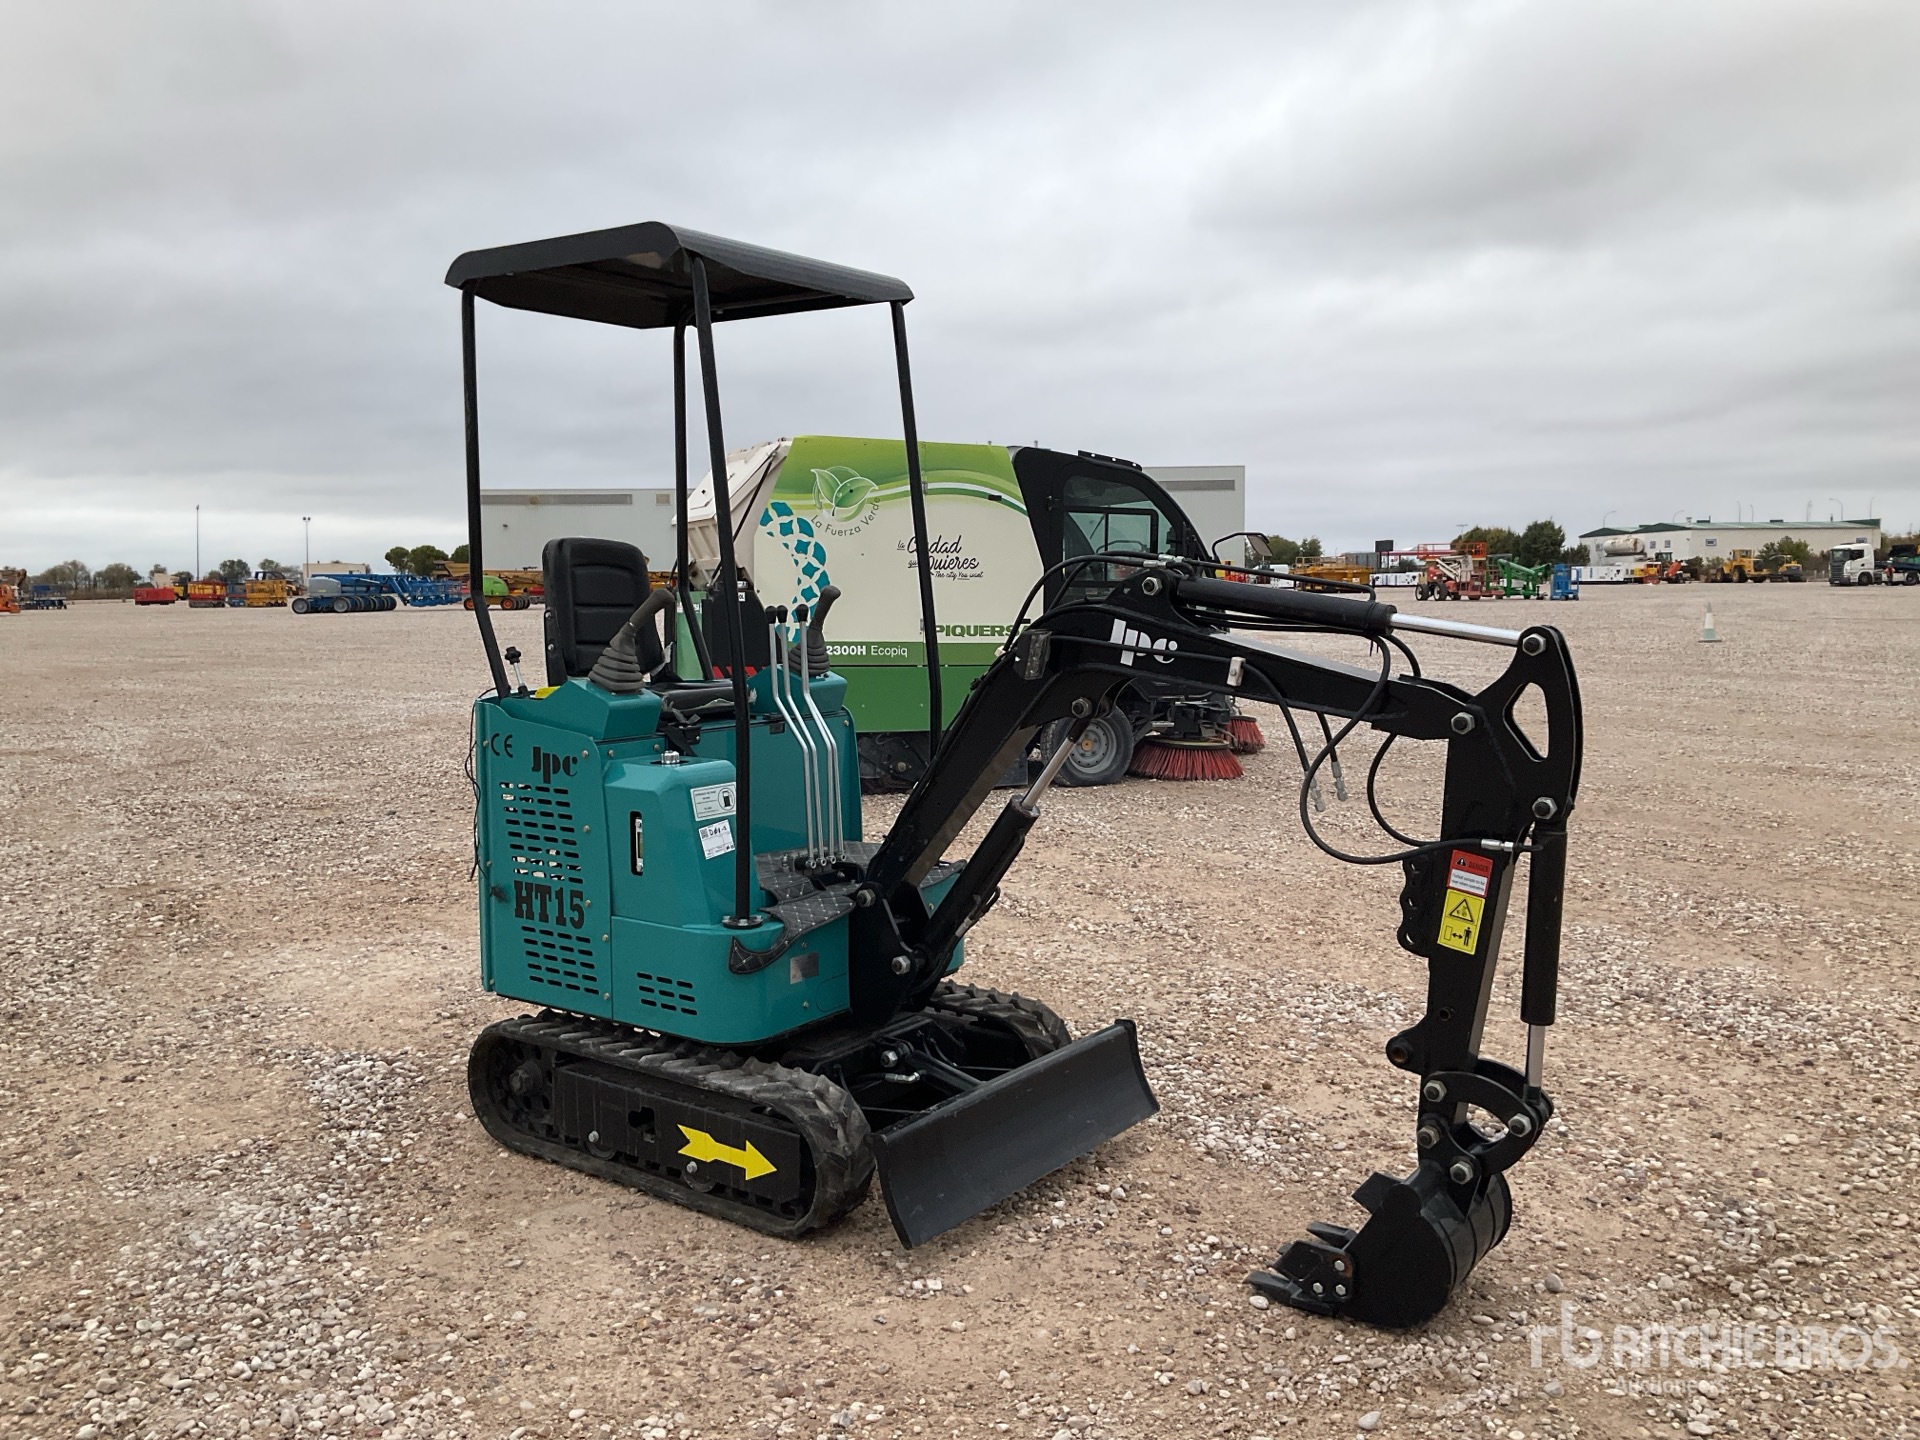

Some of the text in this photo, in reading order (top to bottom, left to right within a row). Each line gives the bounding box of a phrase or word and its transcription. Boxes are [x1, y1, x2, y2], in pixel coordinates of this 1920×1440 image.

[810, 497, 881, 537] La Fuerza Verde
[906, 534, 963, 554] Cdad
[825, 645, 908, 658] 2300H Ecopiq
[514, 880, 585, 930] HT15
